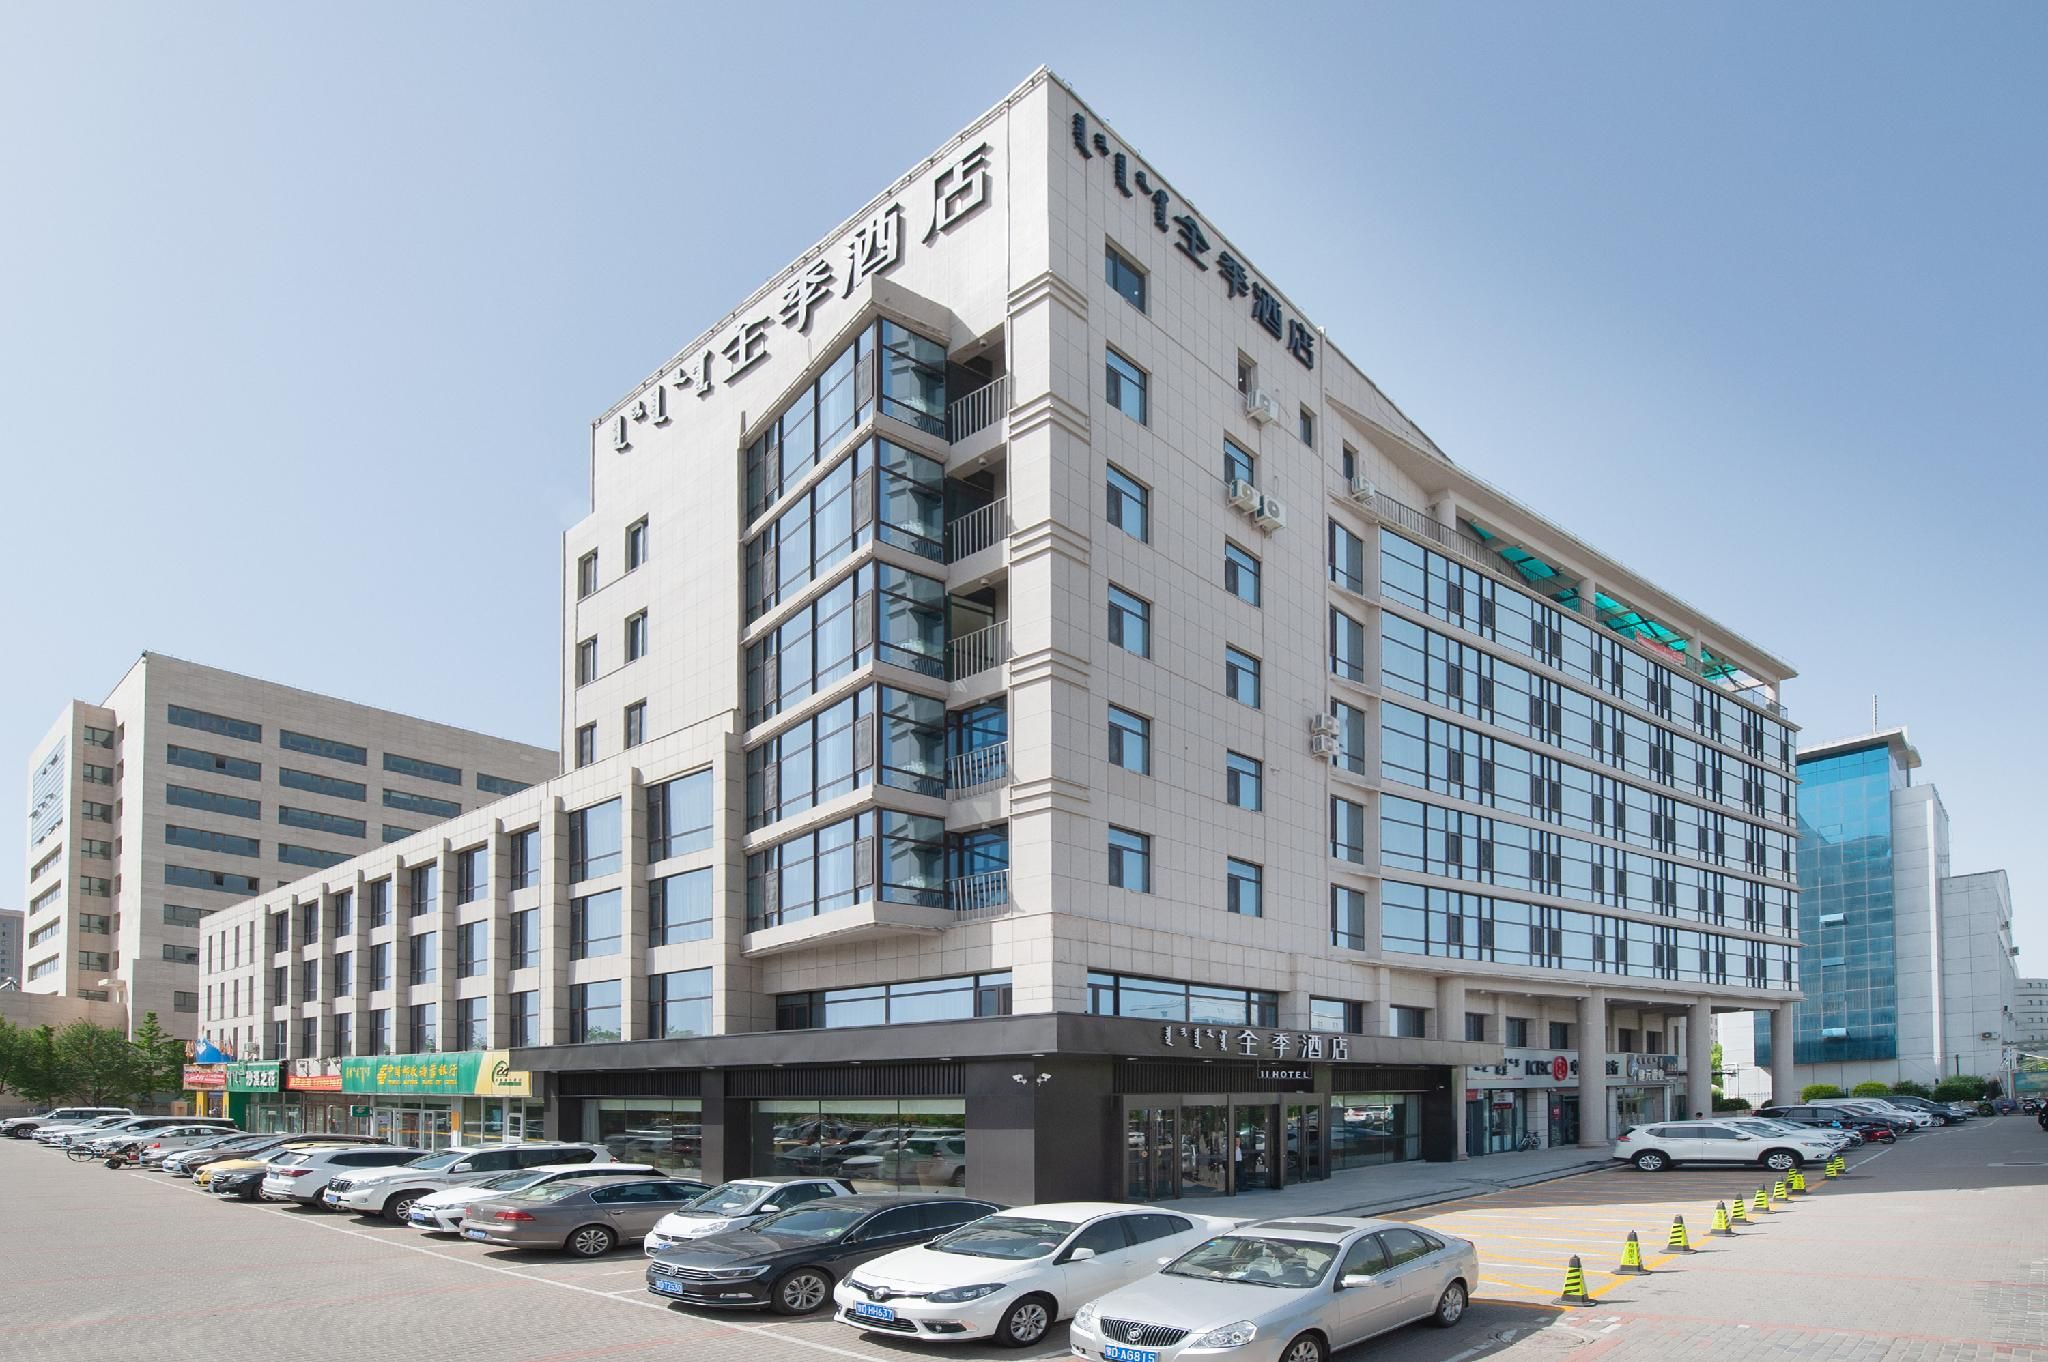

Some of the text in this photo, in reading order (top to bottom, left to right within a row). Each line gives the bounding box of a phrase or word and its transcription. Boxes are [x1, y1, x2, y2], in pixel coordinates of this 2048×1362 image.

[722, 141, 988, 384] 全季酒店
[1173, 215, 1315, 371] 全季酒店
[1237, 1029, 1348, 1060] 全季酒店
[1272, 1070, 1309, 1079] HOTEL
[1525, 1060, 1551, 1075] ICBC
